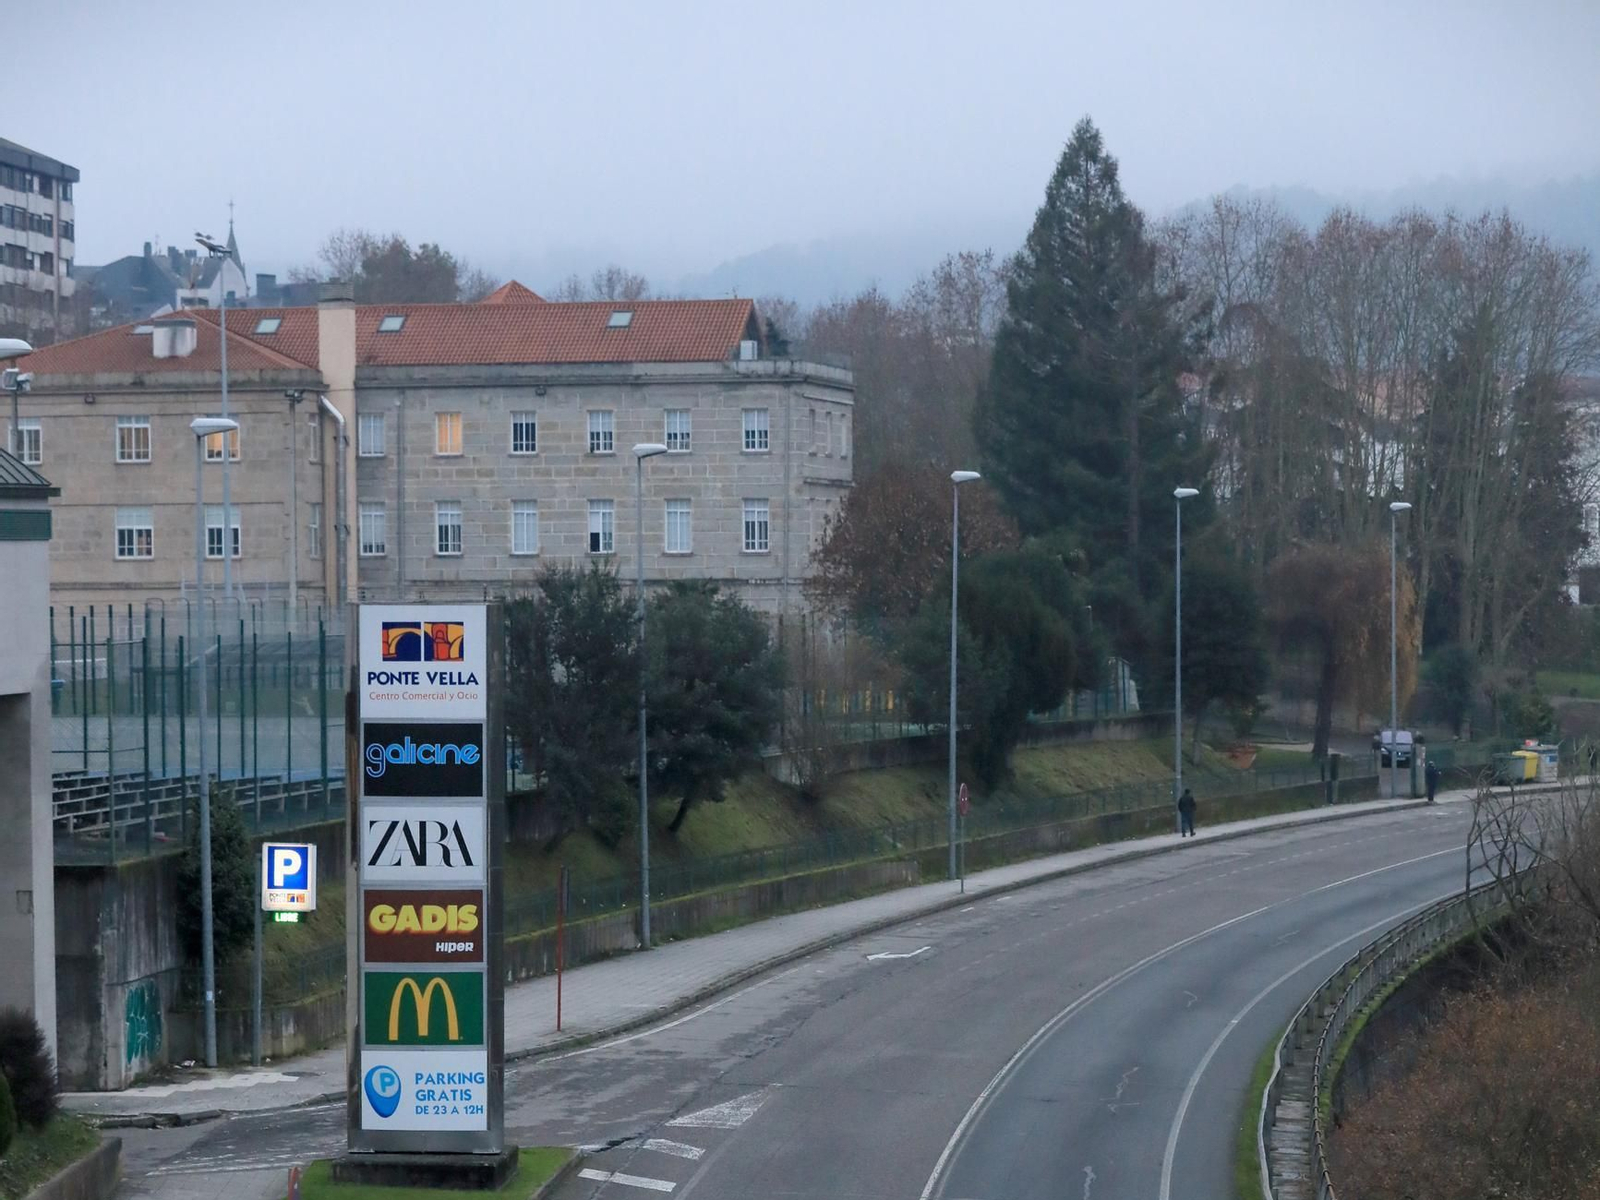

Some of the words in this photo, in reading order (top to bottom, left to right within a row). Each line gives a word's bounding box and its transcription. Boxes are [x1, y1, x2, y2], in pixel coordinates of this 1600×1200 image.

[367, 671, 420, 686] PONTE
[426, 671, 479, 686] VELLA
[369, 691, 400, 701] Centro
[402, 691, 447, 701] Comercial
[449, 693, 455, 702] y
[457, 691, 478, 701] Ocio
[366, 735, 481, 778] galicine
[367, 819, 480, 868] ZARA
[273, 849, 302, 887] P
[368, 904, 479, 934] GADIS
[415, 1072, 485, 1085] PARKING
[415, 1089, 472, 1102] GRATIS
[415, 1105, 429, 1115] DE
[433, 1105, 447, 1115] 23
[450, 1105, 460, 1115] A
[464, 1105, 484, 1115] 12H
